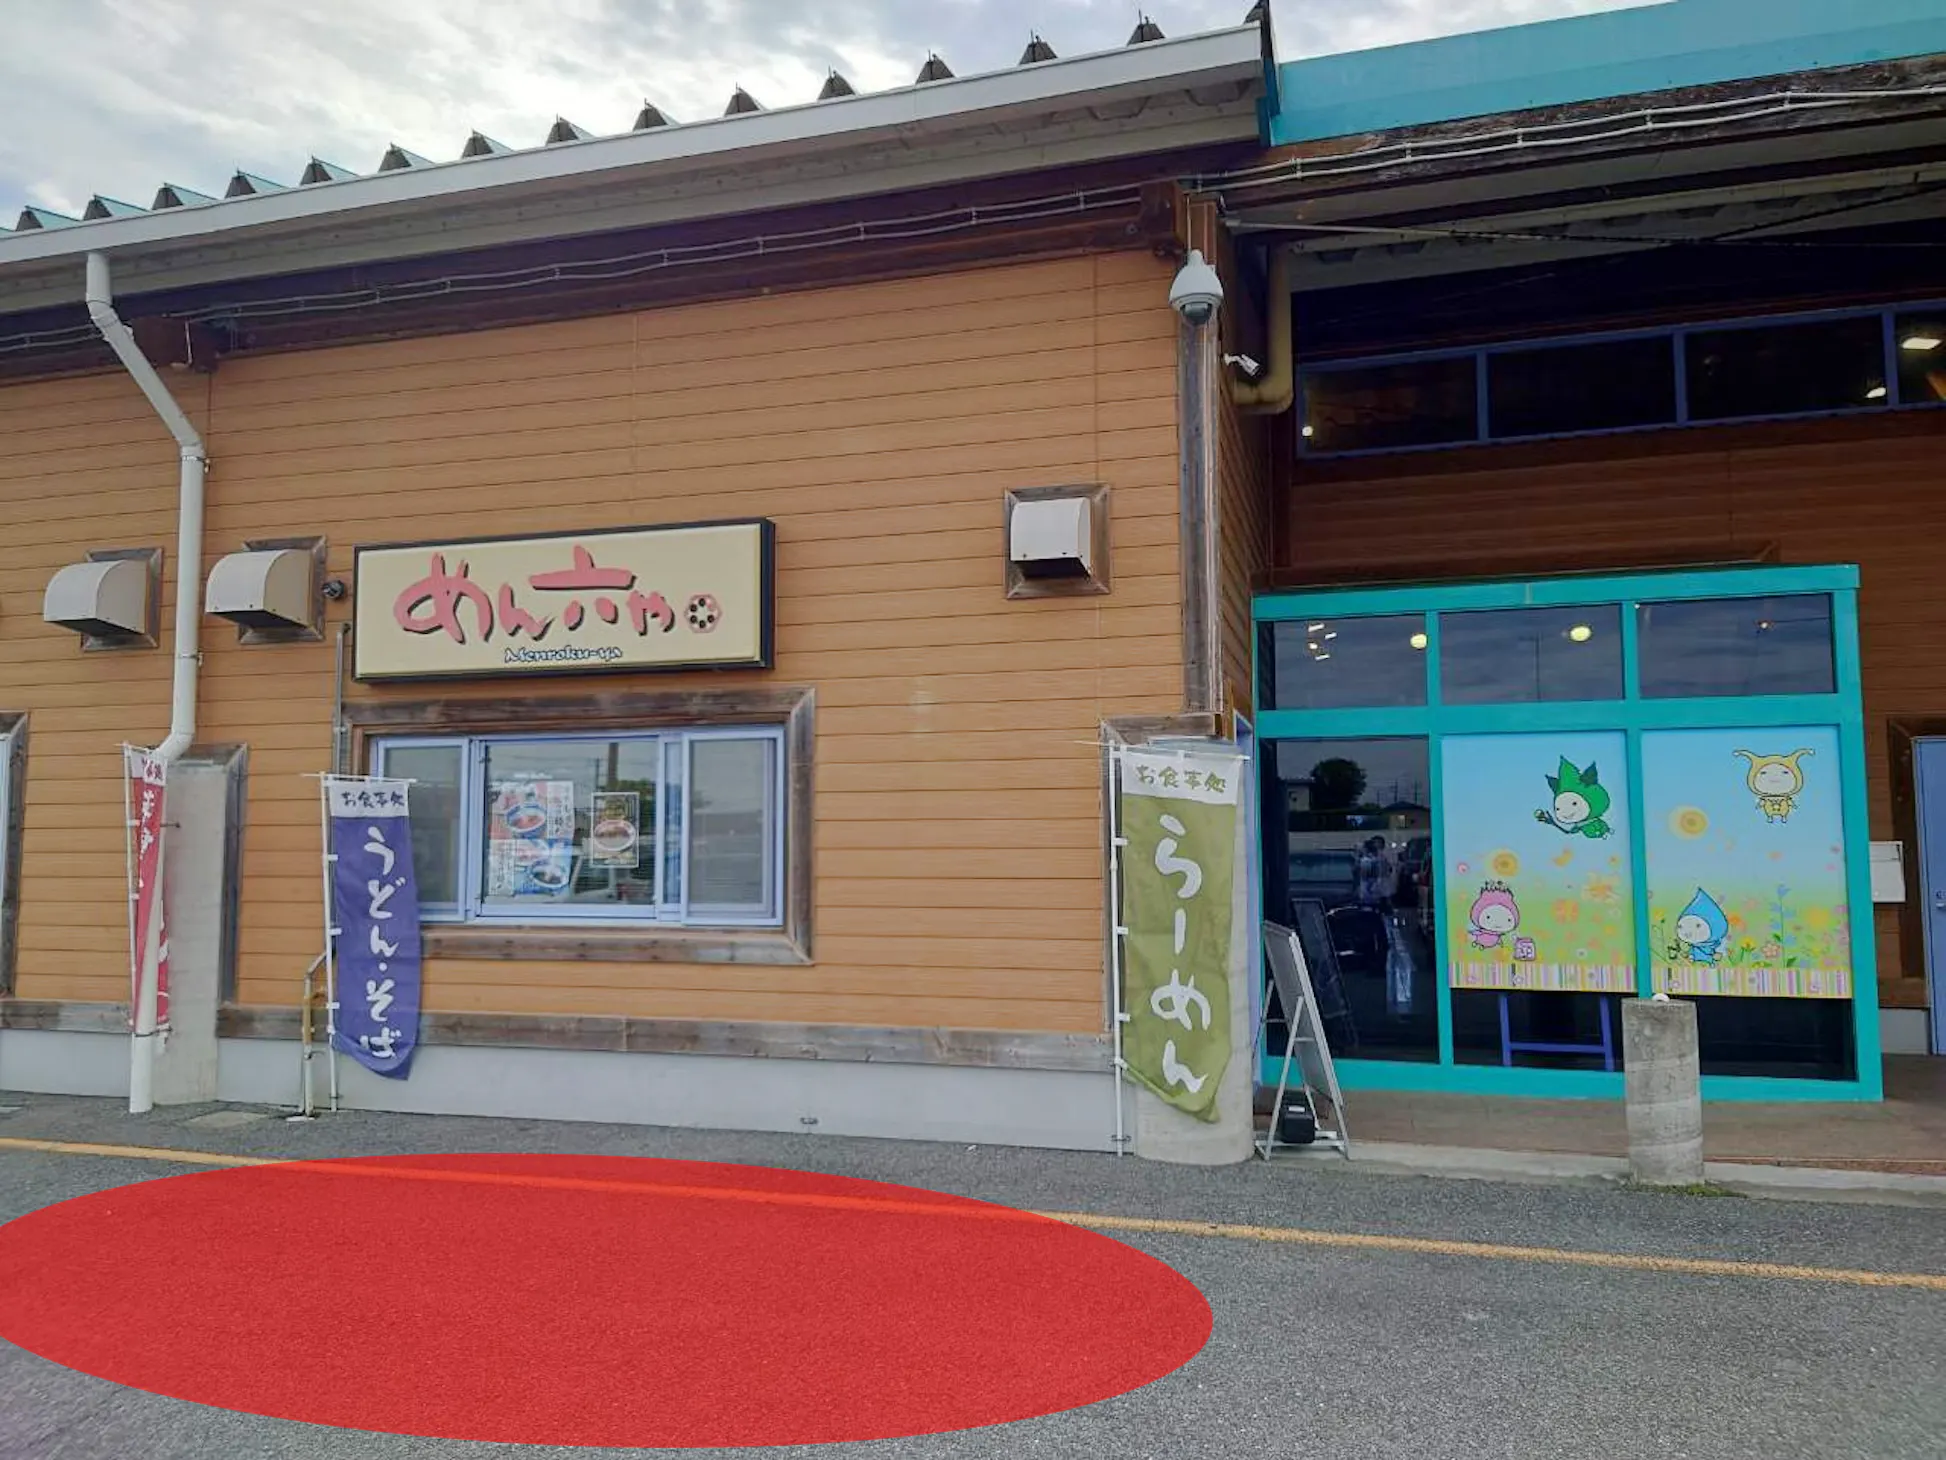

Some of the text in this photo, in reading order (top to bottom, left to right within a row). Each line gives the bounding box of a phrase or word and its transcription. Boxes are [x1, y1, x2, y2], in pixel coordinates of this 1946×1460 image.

[504, 645, 623, 664] Menroku-ya
[1135, 764, 1227, 794] お食事処
[340, 789, 406, 810] お食事処
[1150, 813, 1212, 1094] らーめん
